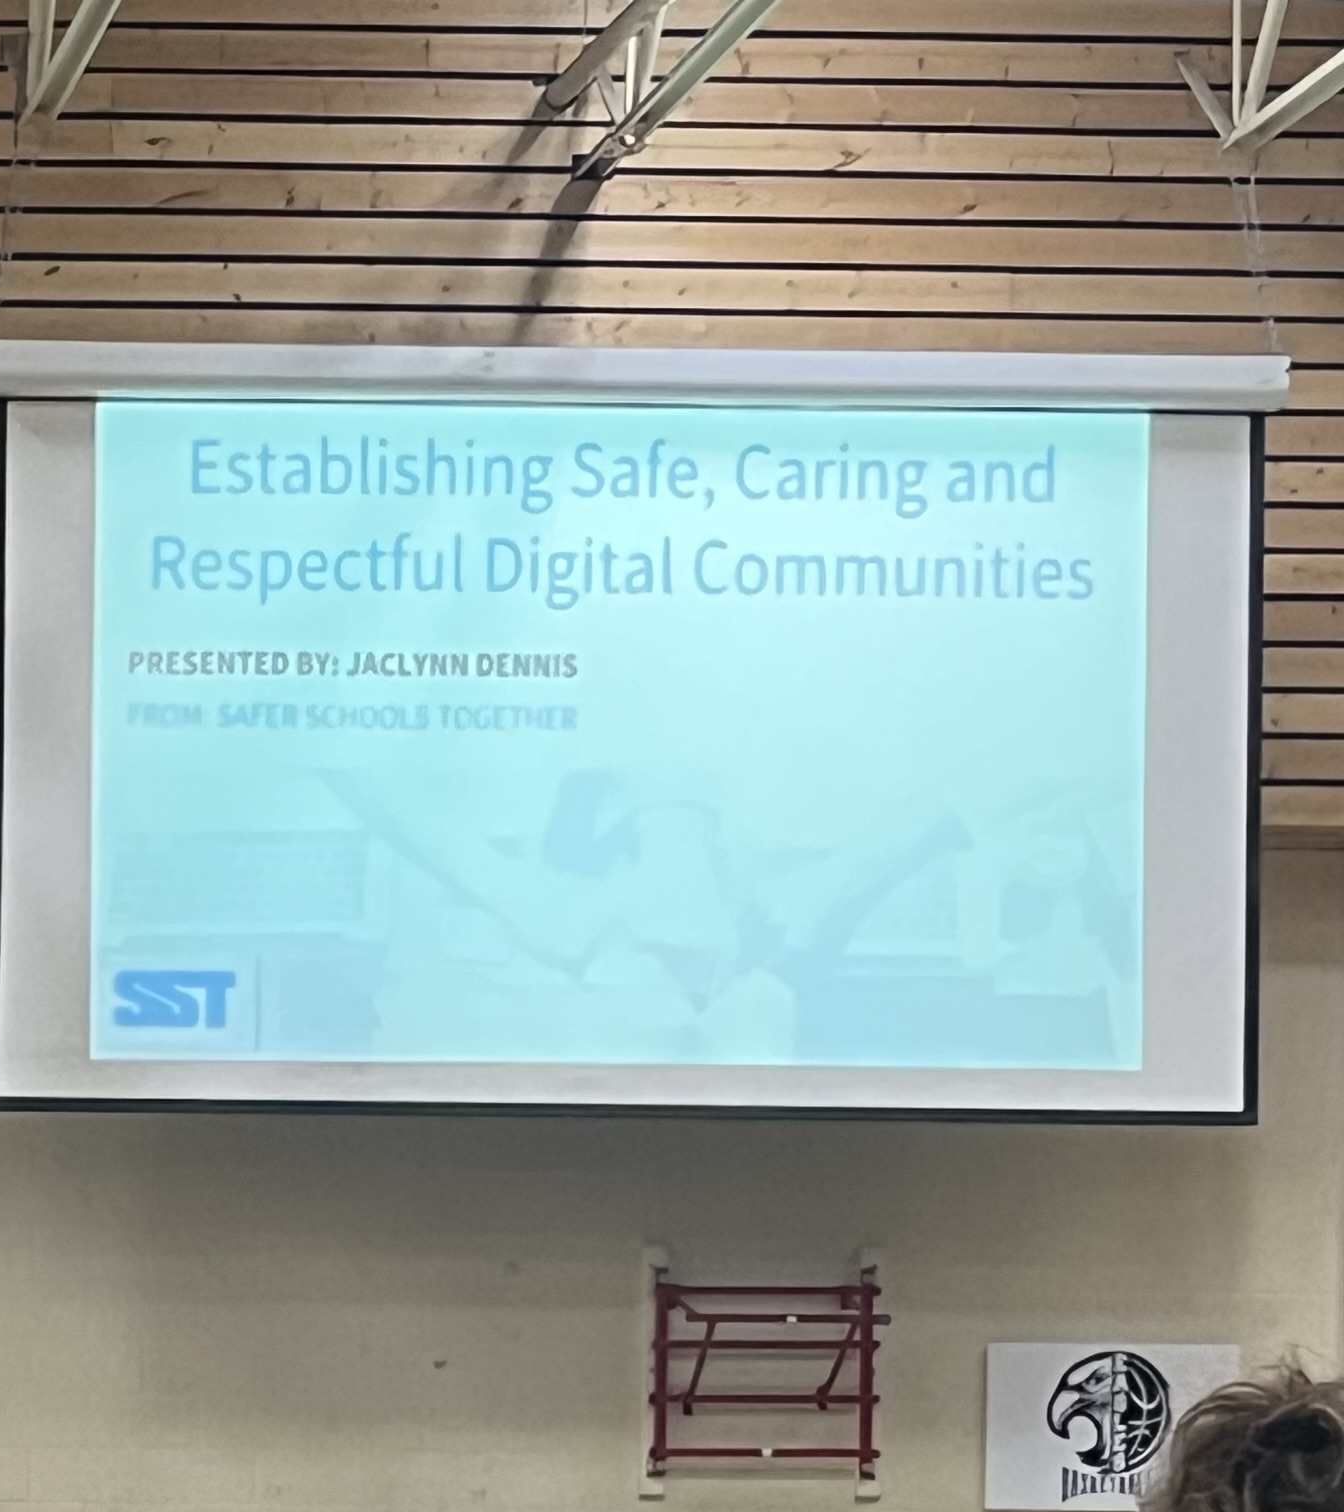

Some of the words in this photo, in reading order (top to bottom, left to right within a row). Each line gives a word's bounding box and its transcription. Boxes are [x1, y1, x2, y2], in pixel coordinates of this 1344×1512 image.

[190, 436, 553, 514] Establishing
[572, 438, 715, 510] Safe,
[735, 443, 927, 519] Caring
[946, 445, 1056, 503] and
[151, 532, 463, 606] Respectful
[486, 536, 672, 611] Digital
[693, 539, 1095, 601] Communities
[127, 650, 290, 675] PRESENTED
[296, 651, 340, 676] BY:
[346, 651, 469, 677] JACLYNN
[476, 652, 579, 678] DENNIS
[217, 703, 298, 729] SAFER
[306, 703, 429, 730] SCHOOLS
[438, 703, 578, 730] TOGETHER
[113, 970, 236, 1029] SST
